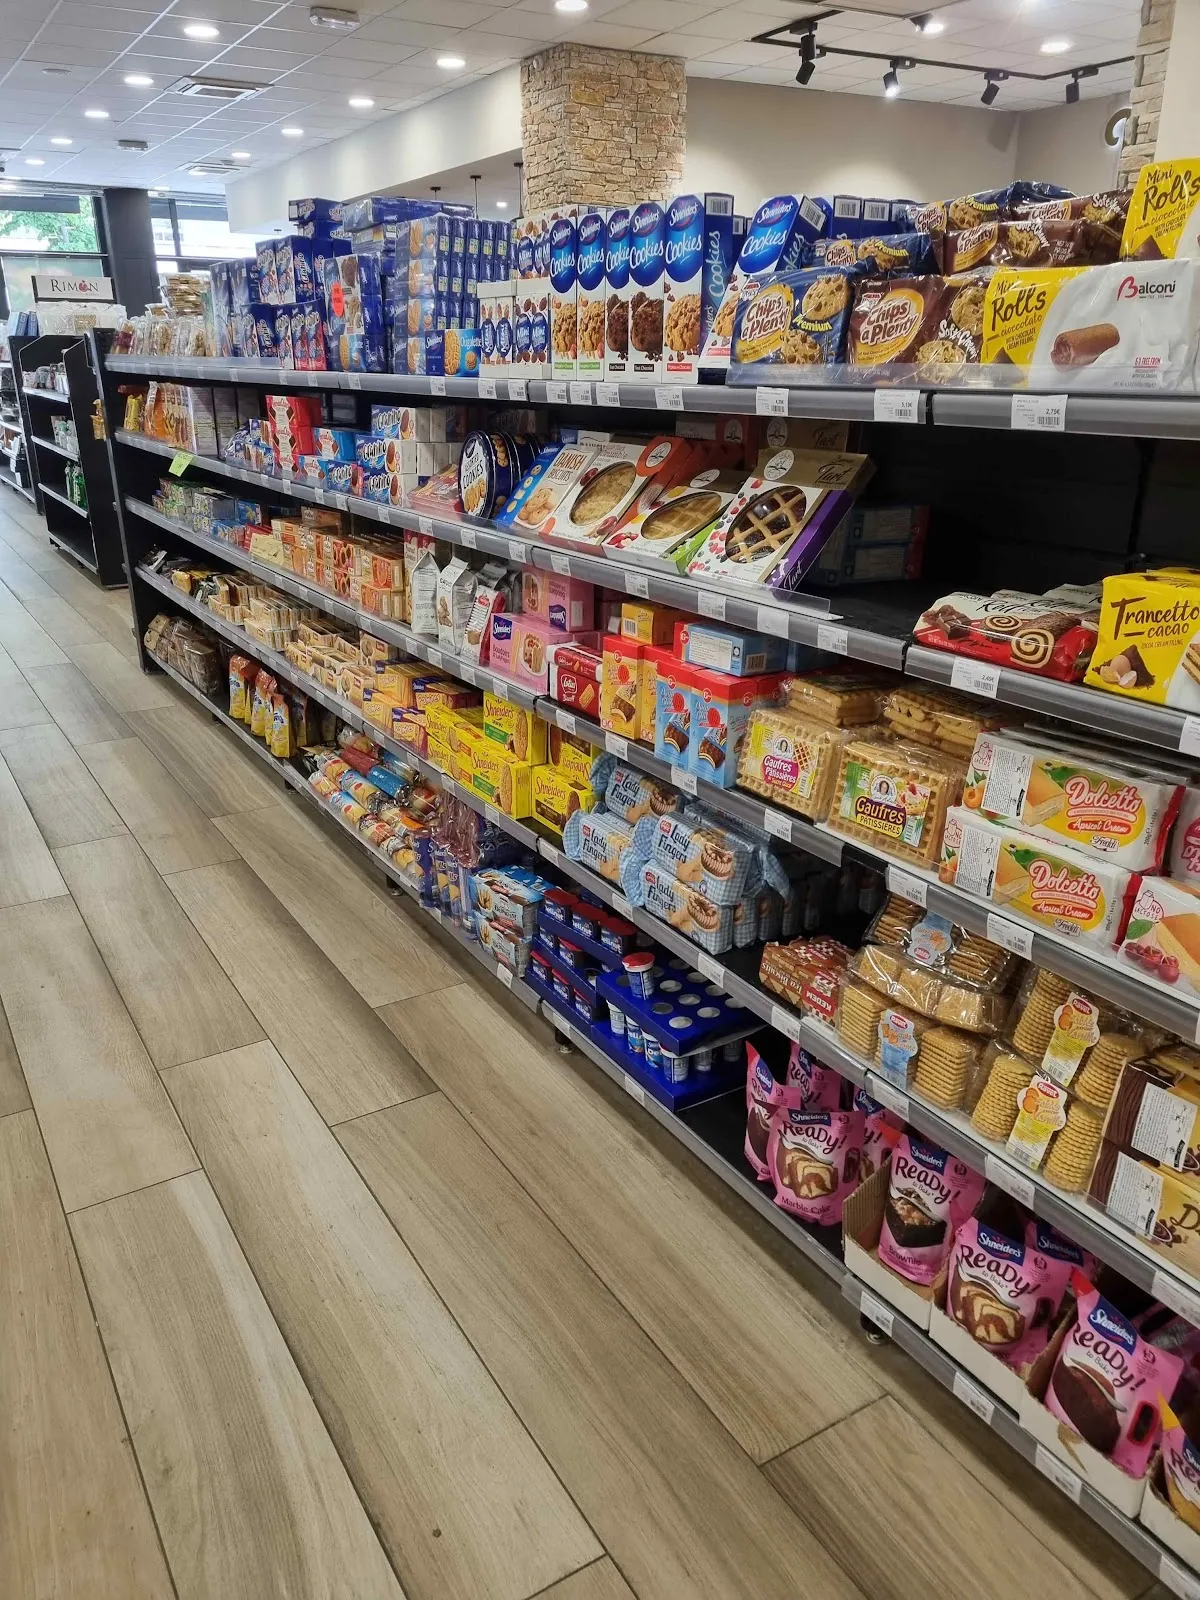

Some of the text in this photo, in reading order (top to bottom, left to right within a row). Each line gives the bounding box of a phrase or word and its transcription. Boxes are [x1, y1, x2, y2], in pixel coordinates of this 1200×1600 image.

[1147, 164, 1175, 186] Mini
[1142, 170, 1200, 221] Rolls
[1151, 197, 1196, 226] cioccolato
[629, 238, 664, 269] Cookies
[665, 232, 702, 264] Cookies
[741, 228, 788, 257] Cookies
[550, 250, 575, 278] Cookies
[577, 246, 605, 275] Cookies
[606, 242, 630, 272] Cookie
[705, 230, 725, 298] Cookies
[1116, 276, 1176, 301] Balconi
[746, 296, 783, 323] Chips
[866, 299, 910, 325] Chips
[991, 283, 1047, 332] Rolls
[860, 329, 870, 344] a
[1000, 311, 1043, 337] cioccolato
[554, 452, 587, 471] DANISH
[463, 463, 484, 489] COOKIES
[1110, 596, 1200, 641] Trancetto
[1147, 622, 1190, 638] cacao
[764, 755, 792, 773] Gaufres
[611, 785, 636, 808] Fingers
[622, 774, 641, 798] Lady
[1065, 775, 1143, 814] Dolcetto
[856, 797, 905, 824] Gaufres
[671, 824, 691, 851] Lady
[1072, 817, 1129, 833] Apricot Cream
[583, 837, 607, 864] Fingers
[591, 828, 608, 849] Lady
[658, 835, 687, 864] Fingers
[1090, 836, 1118, 851] Freddi
[656, 875, 675, 898] Lady
[1029, 859, 1101, 901] Dolcetto
[647, 886, 677, 913] Fingers
[1037, 900, 1090, 919] Apricot Cream
[1150, 903, 1161, 914] NO
[1134, 906, 1160, 921] LACTOSE
[761, 962, 789, 985] Biscuits
[805, 990, 832, 1012] KEDEM
[782, 1196, 808, 1213] Marble
[978, 1232, 1023, 1258] Shneider's
[1089, 1308, 1135, 1346] Shneider's
[1086, 1351, 1093, 1359] to
